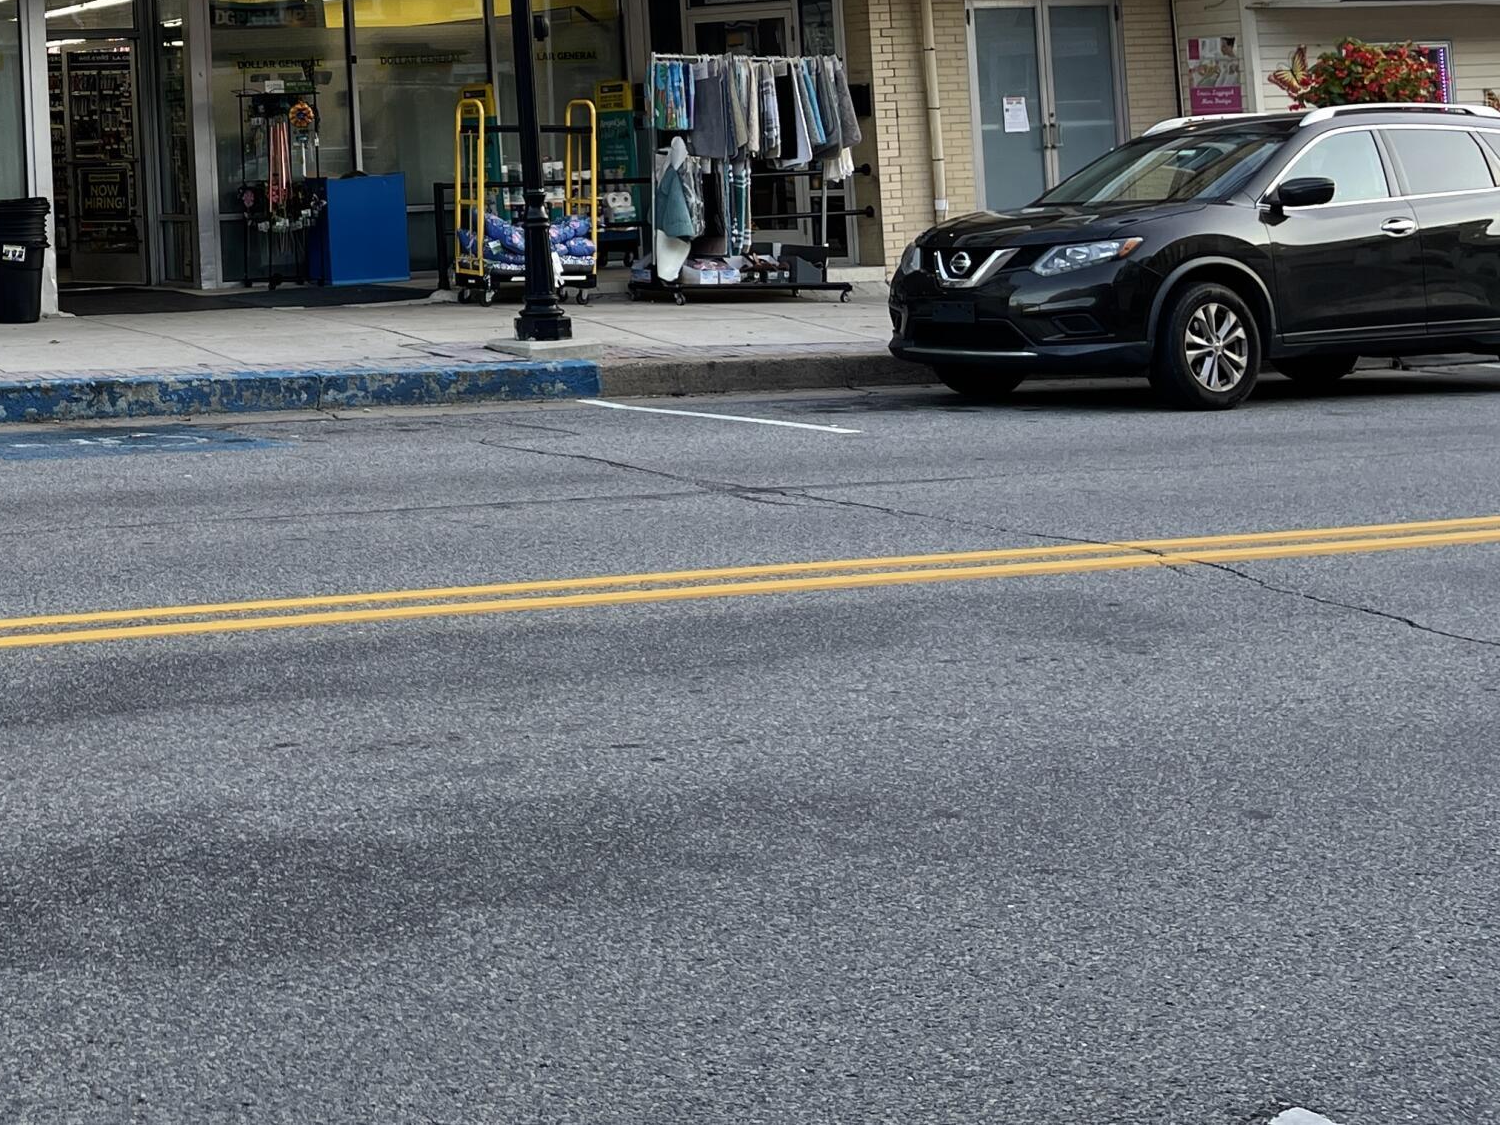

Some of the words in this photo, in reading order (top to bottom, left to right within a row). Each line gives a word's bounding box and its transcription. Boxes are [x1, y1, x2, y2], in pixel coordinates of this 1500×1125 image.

[380, 56, 418, 65] DOLLAR
[420, 53, 462, 64] GENERAL
[557, 50, 598, 60] GENERAL
[237, 60, 276, 69] DOLLAR
[90, 184, 119, 196] NOW
[84, 197, 126, 209] HIRING!
